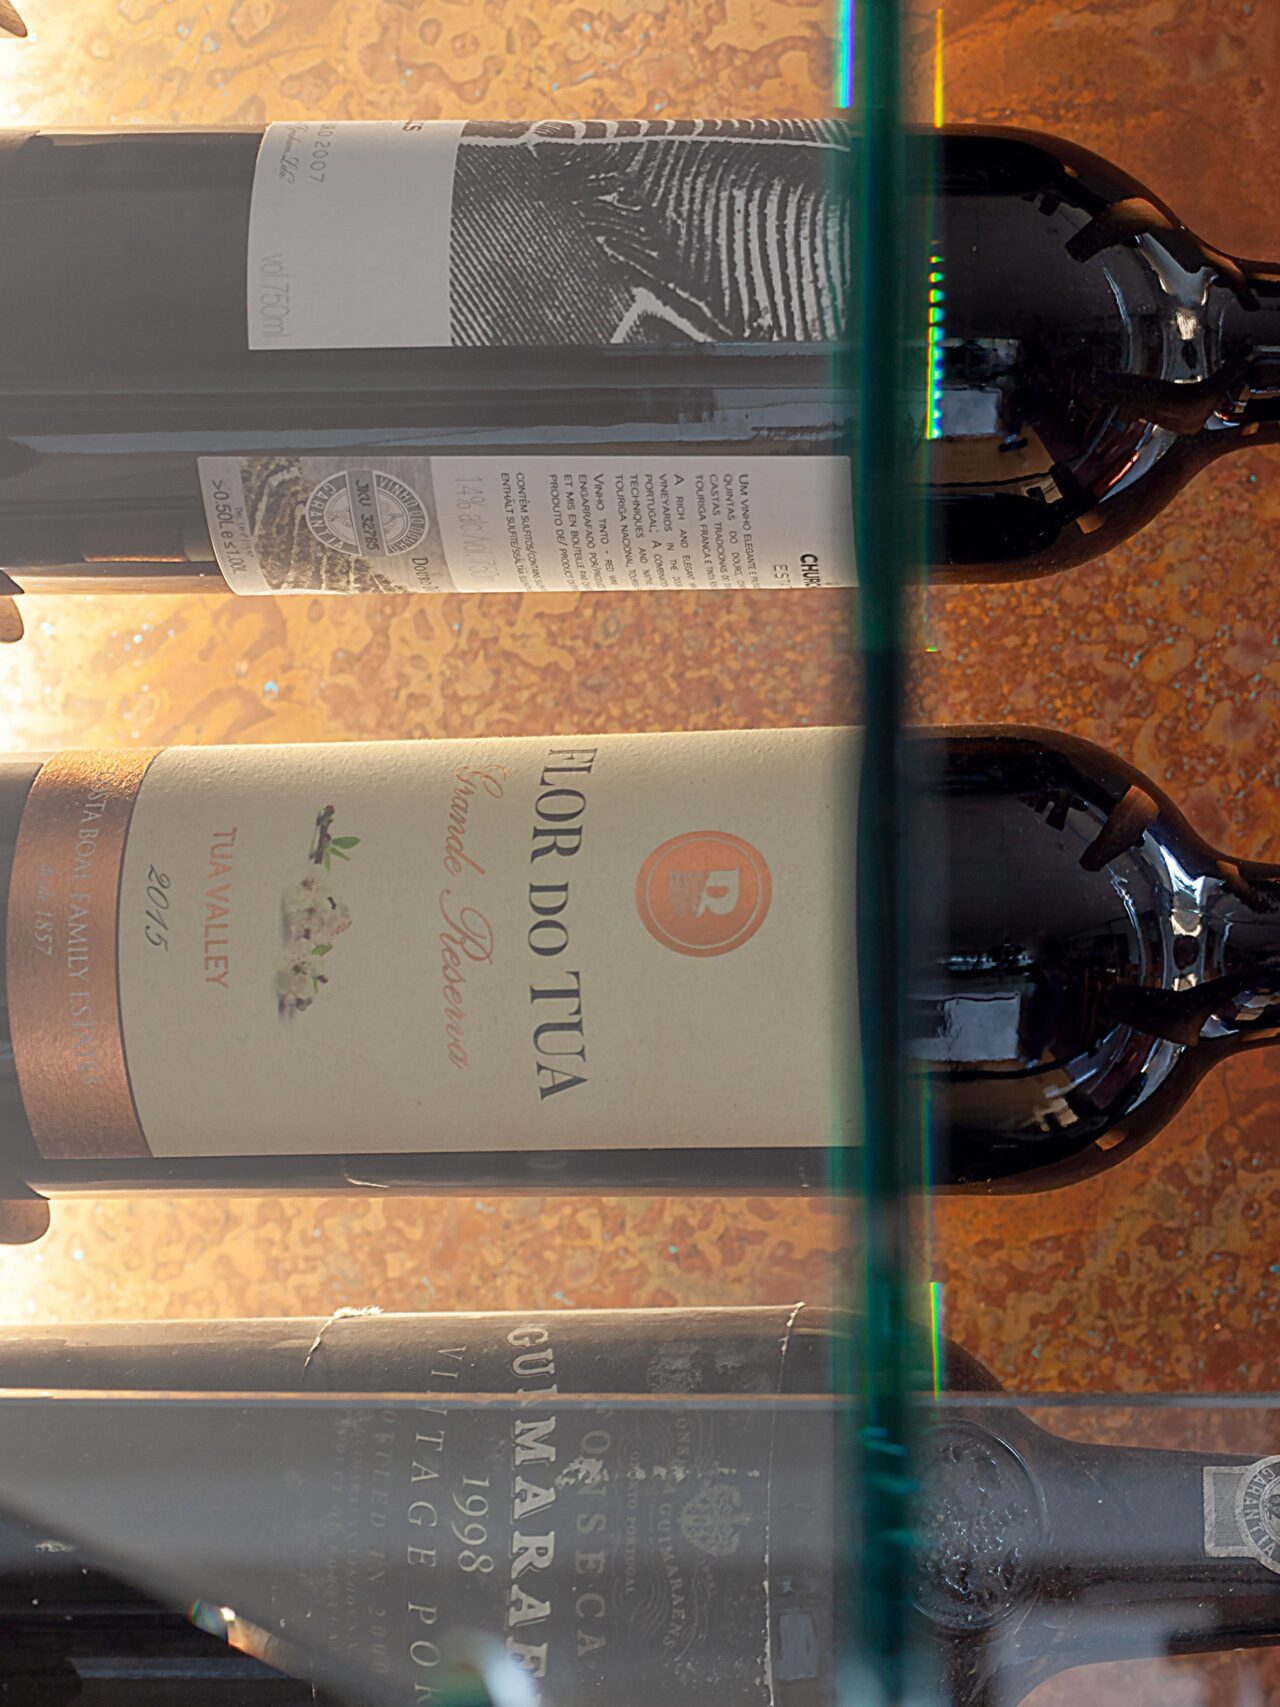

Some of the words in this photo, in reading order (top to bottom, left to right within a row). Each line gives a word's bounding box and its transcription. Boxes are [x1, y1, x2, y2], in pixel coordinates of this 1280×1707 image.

[309, 141, 331, 183] 2007
[356, 480, 371, 507] JKU
[378, 476, 418, 508] VINHO
[410, 510, 424, 524] DO
[455, 476, 486, 510] 14%
[501, 473, 515, 514] ENTHÄLT
[516, 473, 531, 513] CONTÉM
[564, 474, 573, 486] ET
[565, 491, 575, 510] MIS
[615, 474, 627, 521] TOURIGA
[659, 473, 672, 532] VINEYARDS
[674, 474, 685, 486] A
[695, 474, 707, 521] TOURIGA
[709, 474, 721, 516] CASTAS
[739, 474, 749, 495] UM
[310, 482, 344, 549] GARANTIA
[549, 474, 563, 526] PRODUTO
[559, 548, 573, 578] PRODUCT
[568, 514, 578, 527] EN
[578, 474, 595, 549] ENGARRAFADO
[593, 474, 605, 511] VINHO
[599, 518, 609, 544] TINTO
[630, 474, 644, 538] TECHNIQUES
[638, 547, 648, 564] AND
[676, 496, 686, 520] RICH
[723, 474, 735, 520] QUINTAS
[729, 530, 738, 544] DO
[740, 499, 751, 531] VINHO
[570, 530, 586, 568] BOUTEILLE
[651, 540, 662, 549] A
[667, 543, 675, 551] IN
[679, 529, 689, 548] AND
[700, 524, 711, 559] FRANCA
[714, 522, 728, 573] TRADICIONAIS
[744, 534, 757, 570] ELEGANTE
[669, 559, 678, 571] THE
[443, 764, 507, 876] Grande
[529, 748, 598, 864] FLOR
[73, 829, 98, 882] BOAL
[206, 827, 237, 878] TUA
[144, 864, 171, 952] 2015
[528, 882, 569, 956] DO
[35, 910, 54, 957] 1857
[67, 893, 90, 982] FAMILY
[204, 884, 230, 988] VALLEY
[439, 889, 494, 1069] Reserva
[68, 992, 101, 1085] ESTATES
[529, 971, 588, 1101] TUA
[452, 1475, 495, 1574] 1998
[1245, 1467, 1276, 1556] GARANTIA
[658, 1503, 686, 1649] GUIMARAENS
